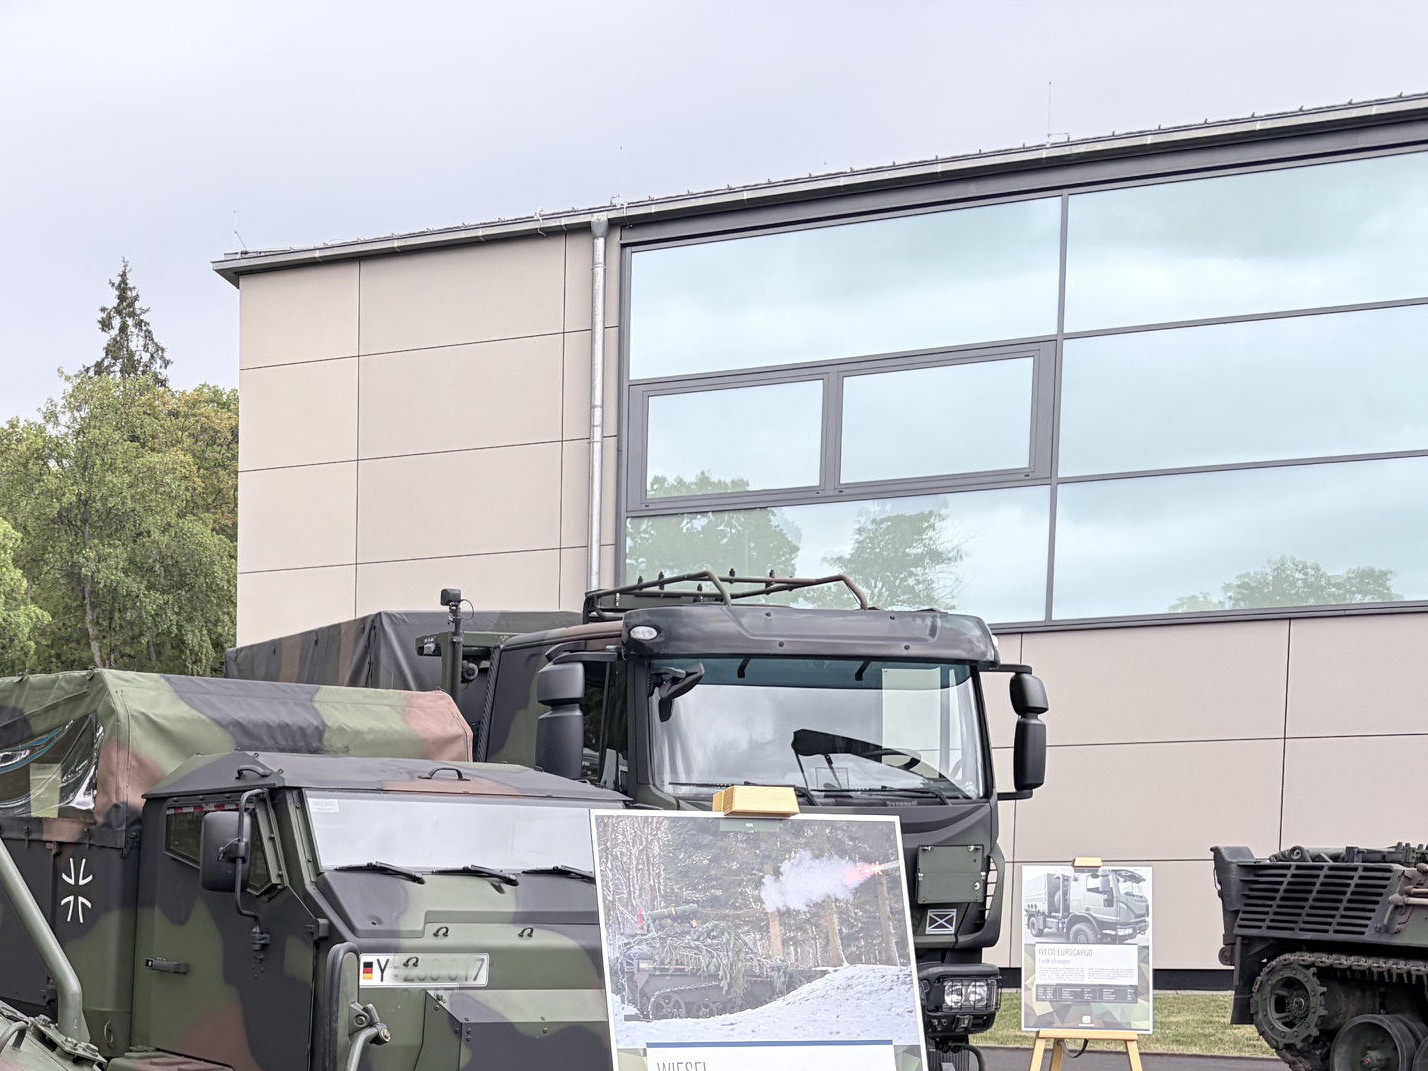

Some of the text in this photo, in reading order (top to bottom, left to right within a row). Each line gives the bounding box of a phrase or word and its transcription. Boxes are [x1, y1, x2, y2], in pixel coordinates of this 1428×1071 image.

[1039, 948, 1093, 957] IVECO EUROCARGO
[376, 959, 390, 982] Y
